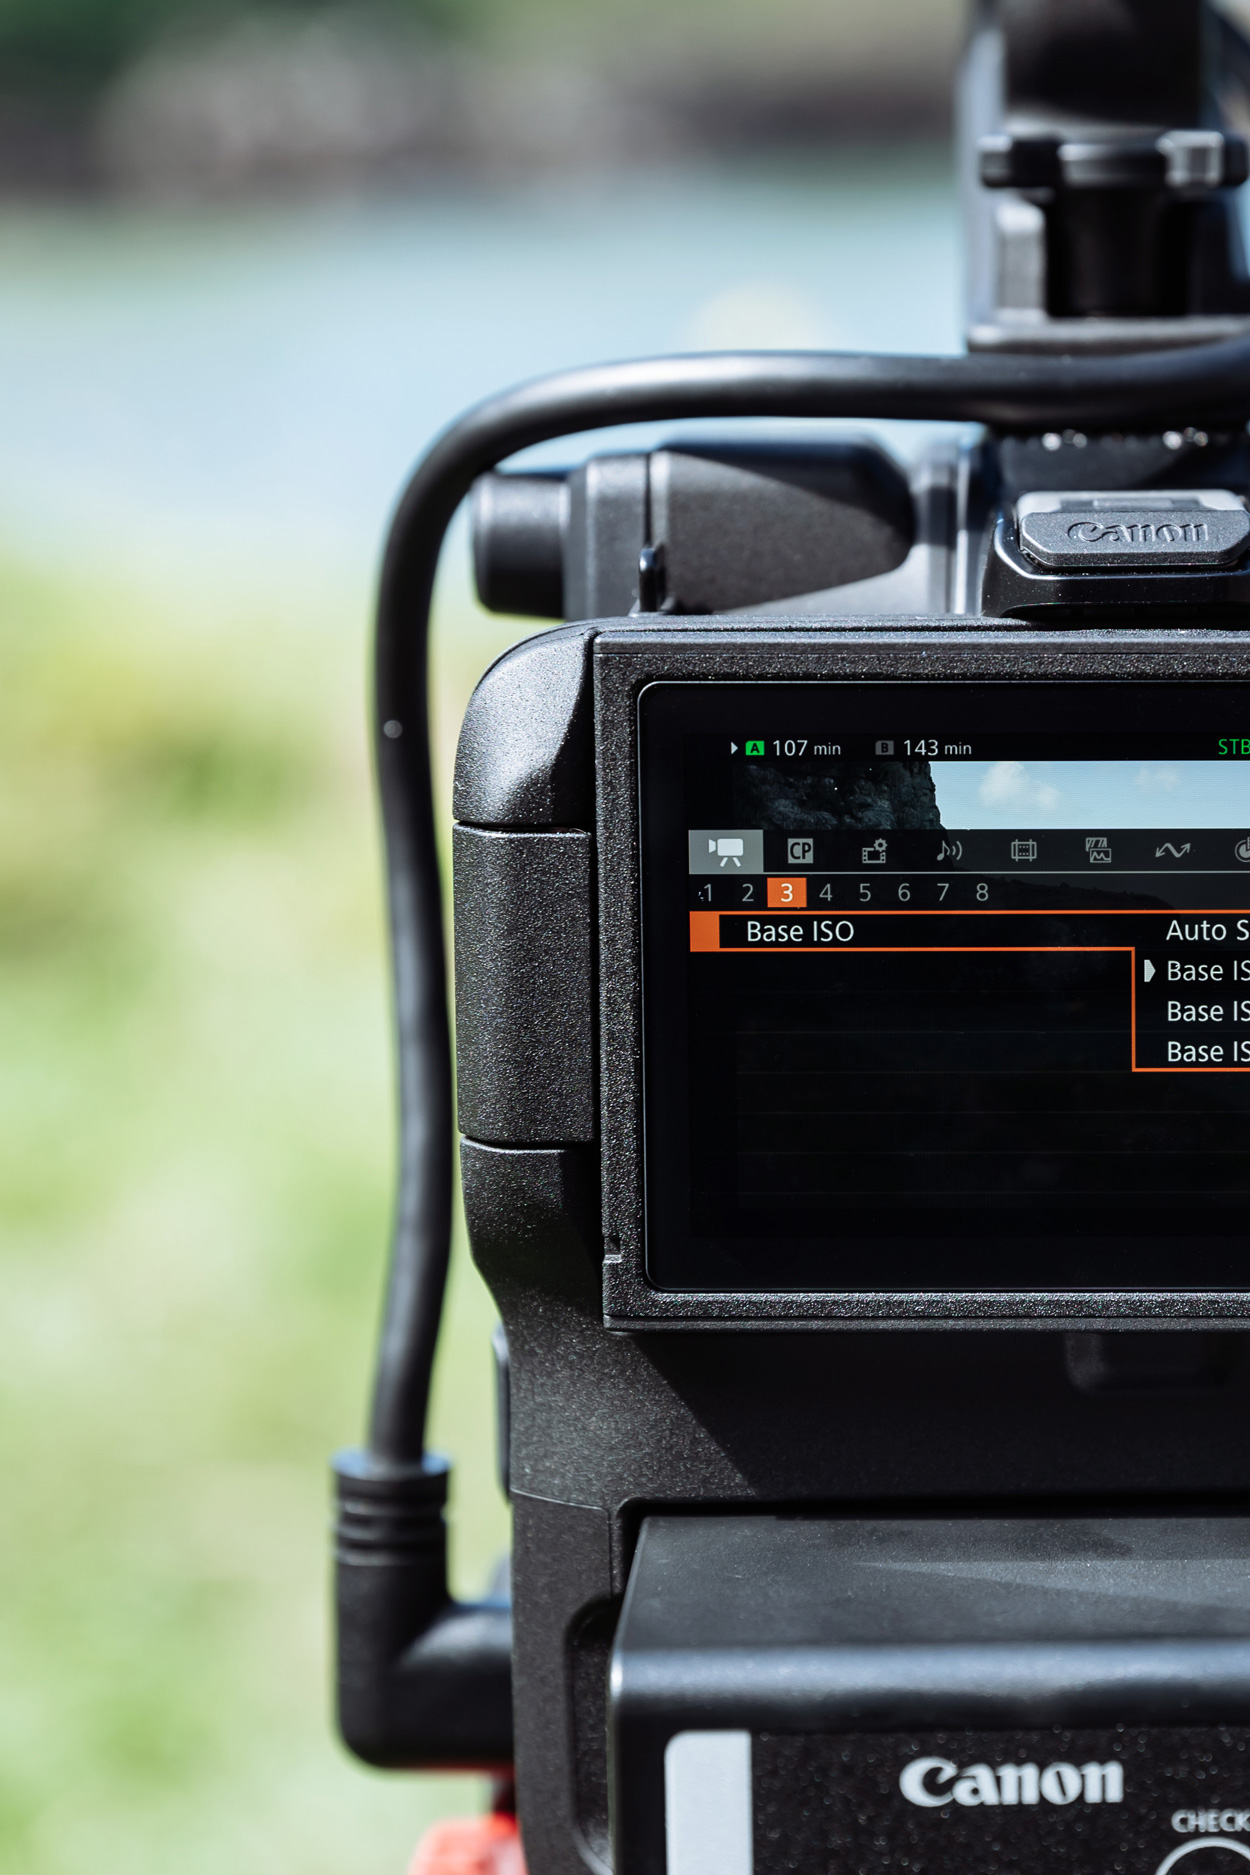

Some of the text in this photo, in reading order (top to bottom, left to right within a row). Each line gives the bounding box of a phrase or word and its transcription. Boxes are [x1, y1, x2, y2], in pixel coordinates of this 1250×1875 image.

[1066, 521, 1210, 543] Canon
[773, 739, 841, 756] 107 min
[904, 739, 972, 756] 143 min
[789, 840, 813, 862] CP
[702, 884, 989, 902] 1 2 3 4 5 6 7 8
[746, 921, 855, 942] Base ISO
[1165, 919, 1227, 941] Auto
[1167, 960, 1224, 981] Base
[1167, 1001, 1224, 1022] Base
[1167, 1041, 1224, 1062] Base
[899, 1756, 1124, 1807] Canon
